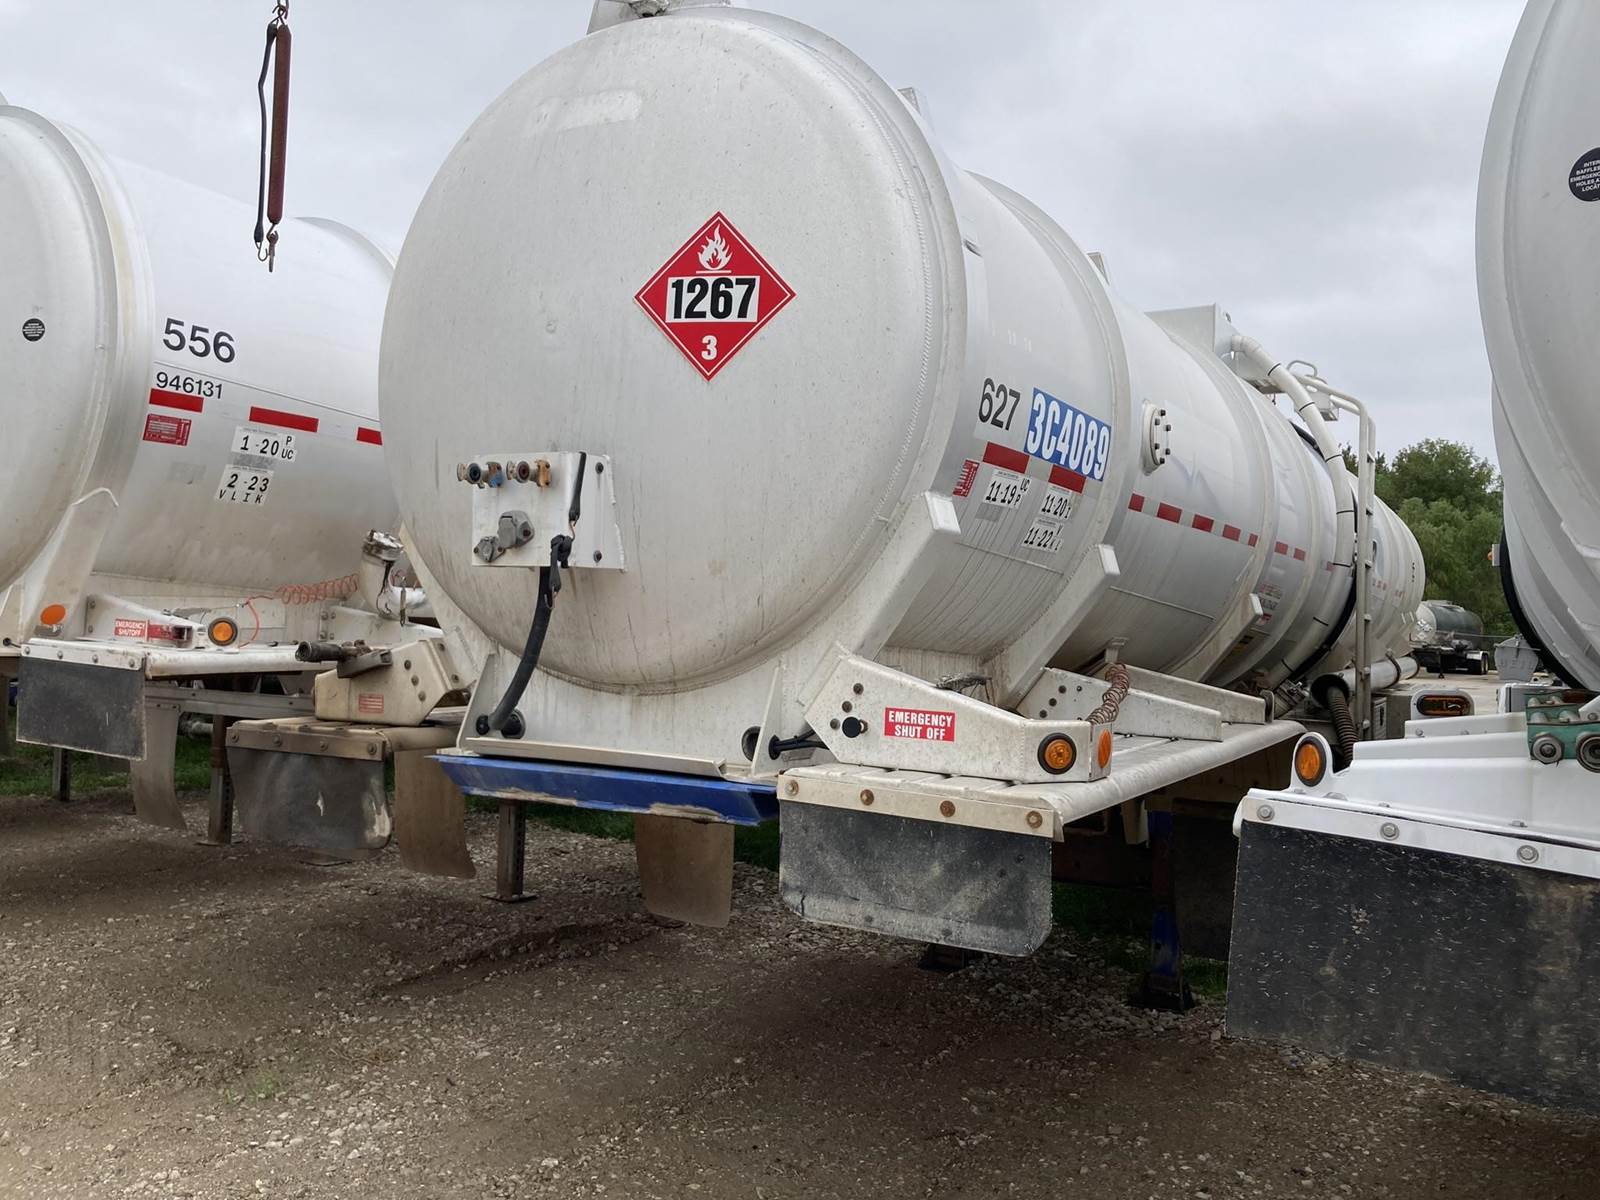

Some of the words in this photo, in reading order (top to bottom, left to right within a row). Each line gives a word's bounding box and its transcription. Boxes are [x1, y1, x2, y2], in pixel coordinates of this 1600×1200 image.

[671, 277, 756, 319] 1267
[163, 317, 236, 363] 556
[701, 335, 718, 361] 3
[156, 371, 223, 399] 946131
[978, 377, 1021, 431] 627
[1027, 392, 1110, 480] 3C4089
[888, 710, 953, 728] EMERGENCY
[894, 724, 922, 738] SHUT
[926, 727, 946, 740] OFF
